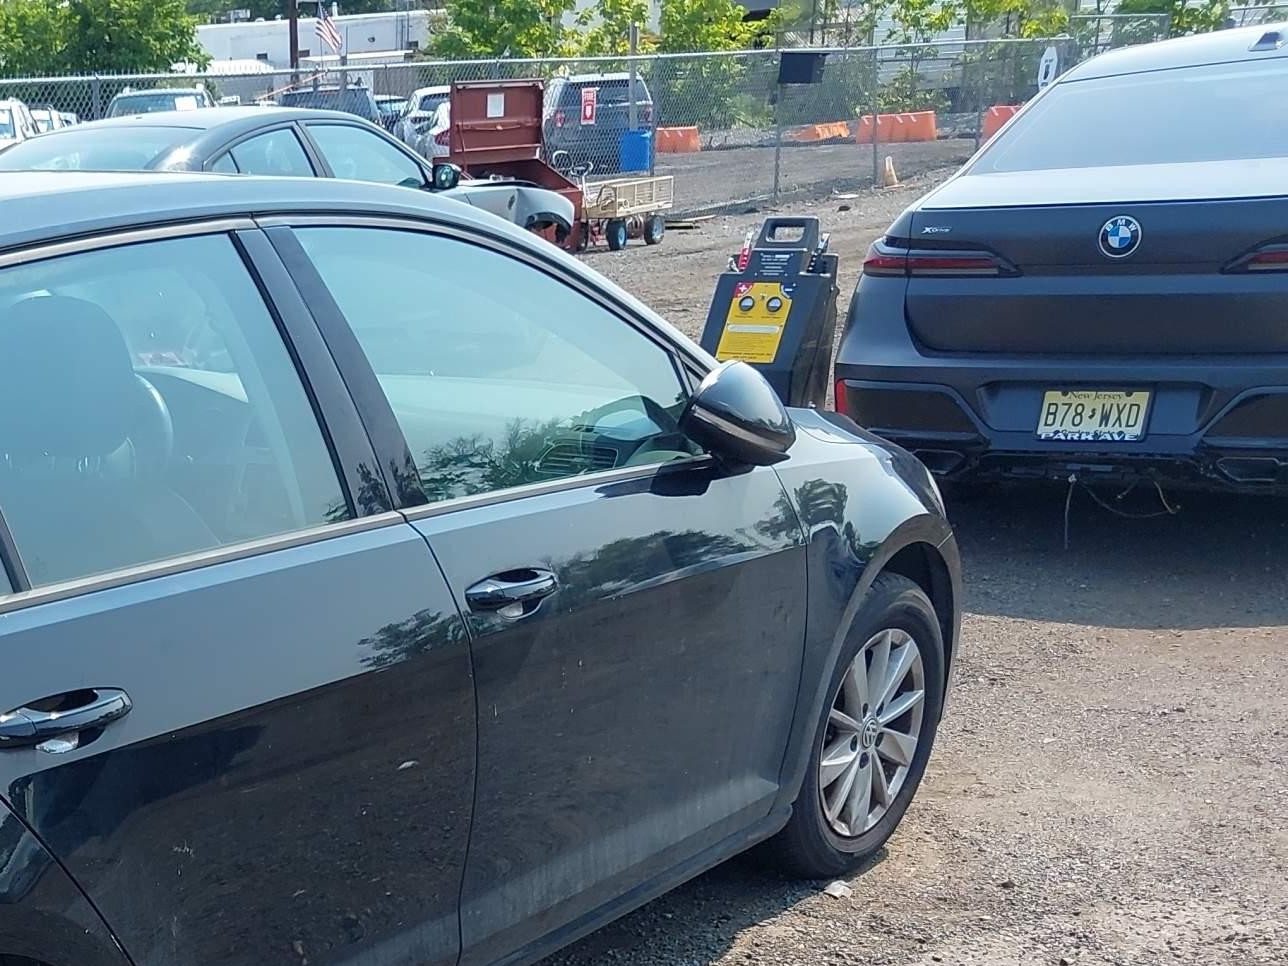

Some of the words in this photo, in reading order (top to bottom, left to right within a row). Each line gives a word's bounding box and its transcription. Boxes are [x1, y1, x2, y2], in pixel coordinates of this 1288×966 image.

[1105, 219, 1138, 231] BMW
[1069, 391, 1091, 400] New
[1094, 391, 1123, 400] Jersey
[1040, 431, 1095, 440] PARK
[1098, 431, 1138, 441] AVE
